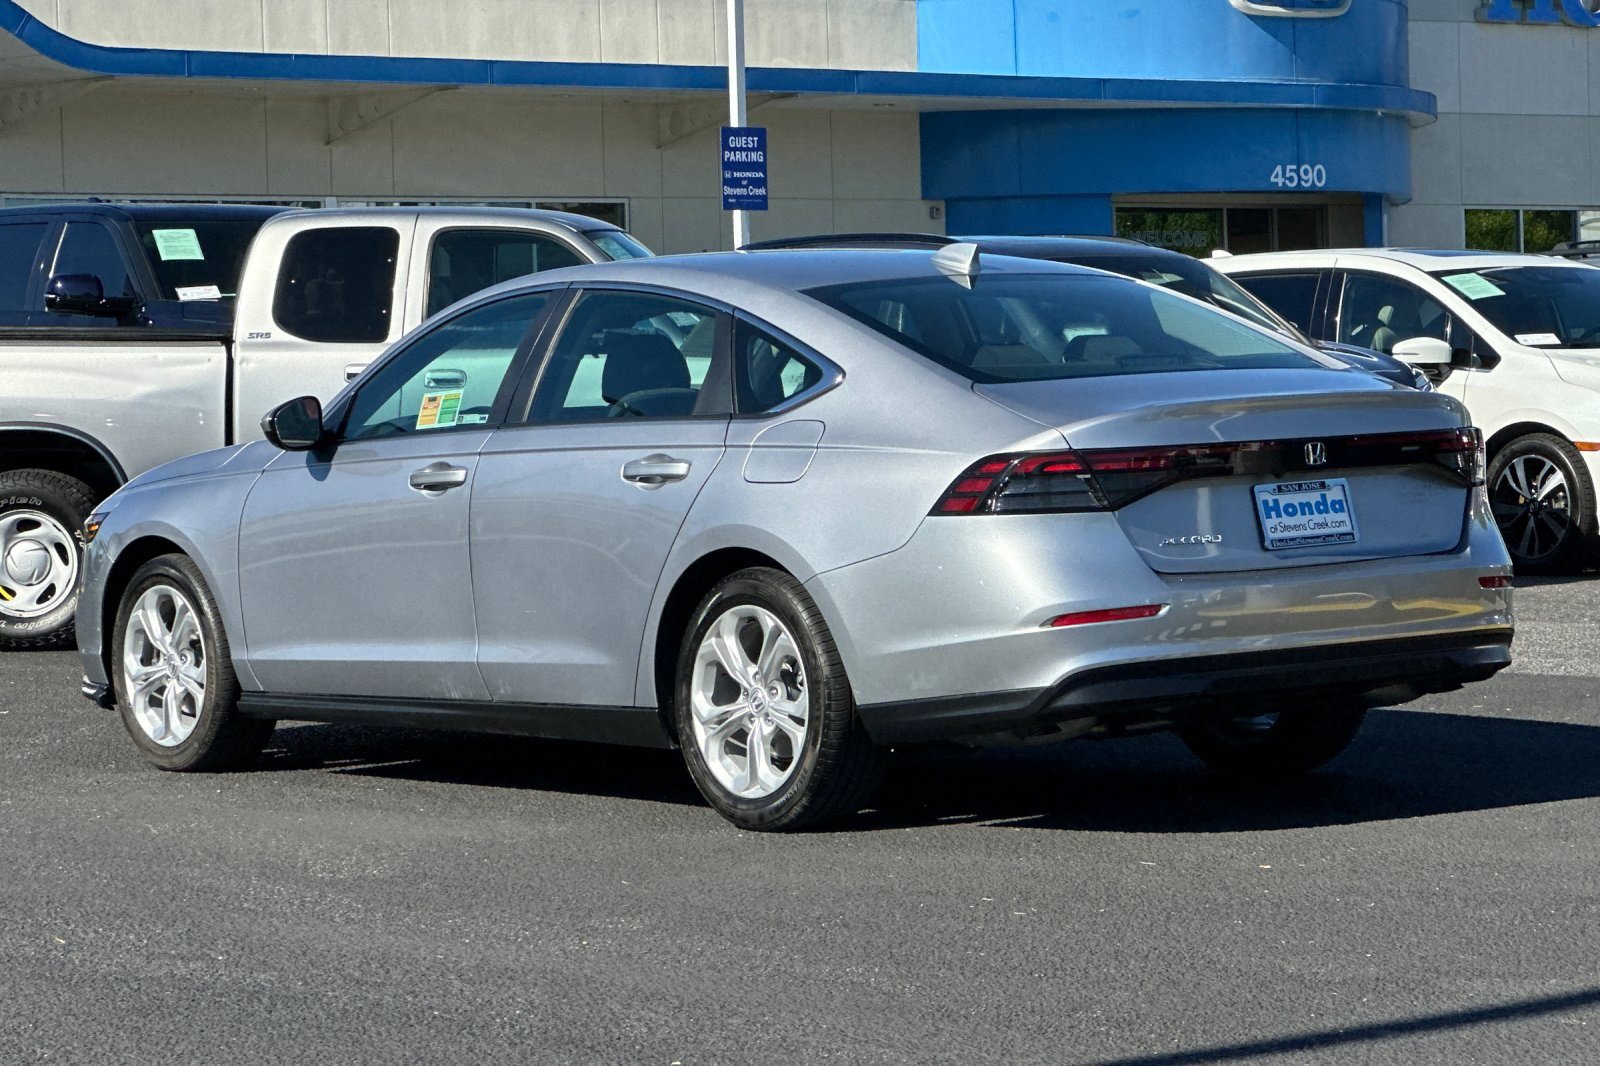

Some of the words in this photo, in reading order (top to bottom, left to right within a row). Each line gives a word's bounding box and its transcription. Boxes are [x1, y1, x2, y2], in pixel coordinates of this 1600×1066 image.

[729, 136, 759, 148] GUEST
[724, 151, 764, 162] PARKING
[1270, 164, 1326, 187] 4590
[723, 185, 748, 196] Stevens
[748, 185, 767, 196] Creek
[1130, 230, 1207, 247] WELCOME
[1281, 484, 1299, 493] SAN
[1301, 481, 1323, 491] JOSE
[1262, 493, 1346, 520] Honda
[1270, 526, 1279, 534] of
[1279, 522, 1308, 533] Stevens
[1307, 517, 1348, 530] Creek.com
[1159, 534, 1223, 547] ACCORD
